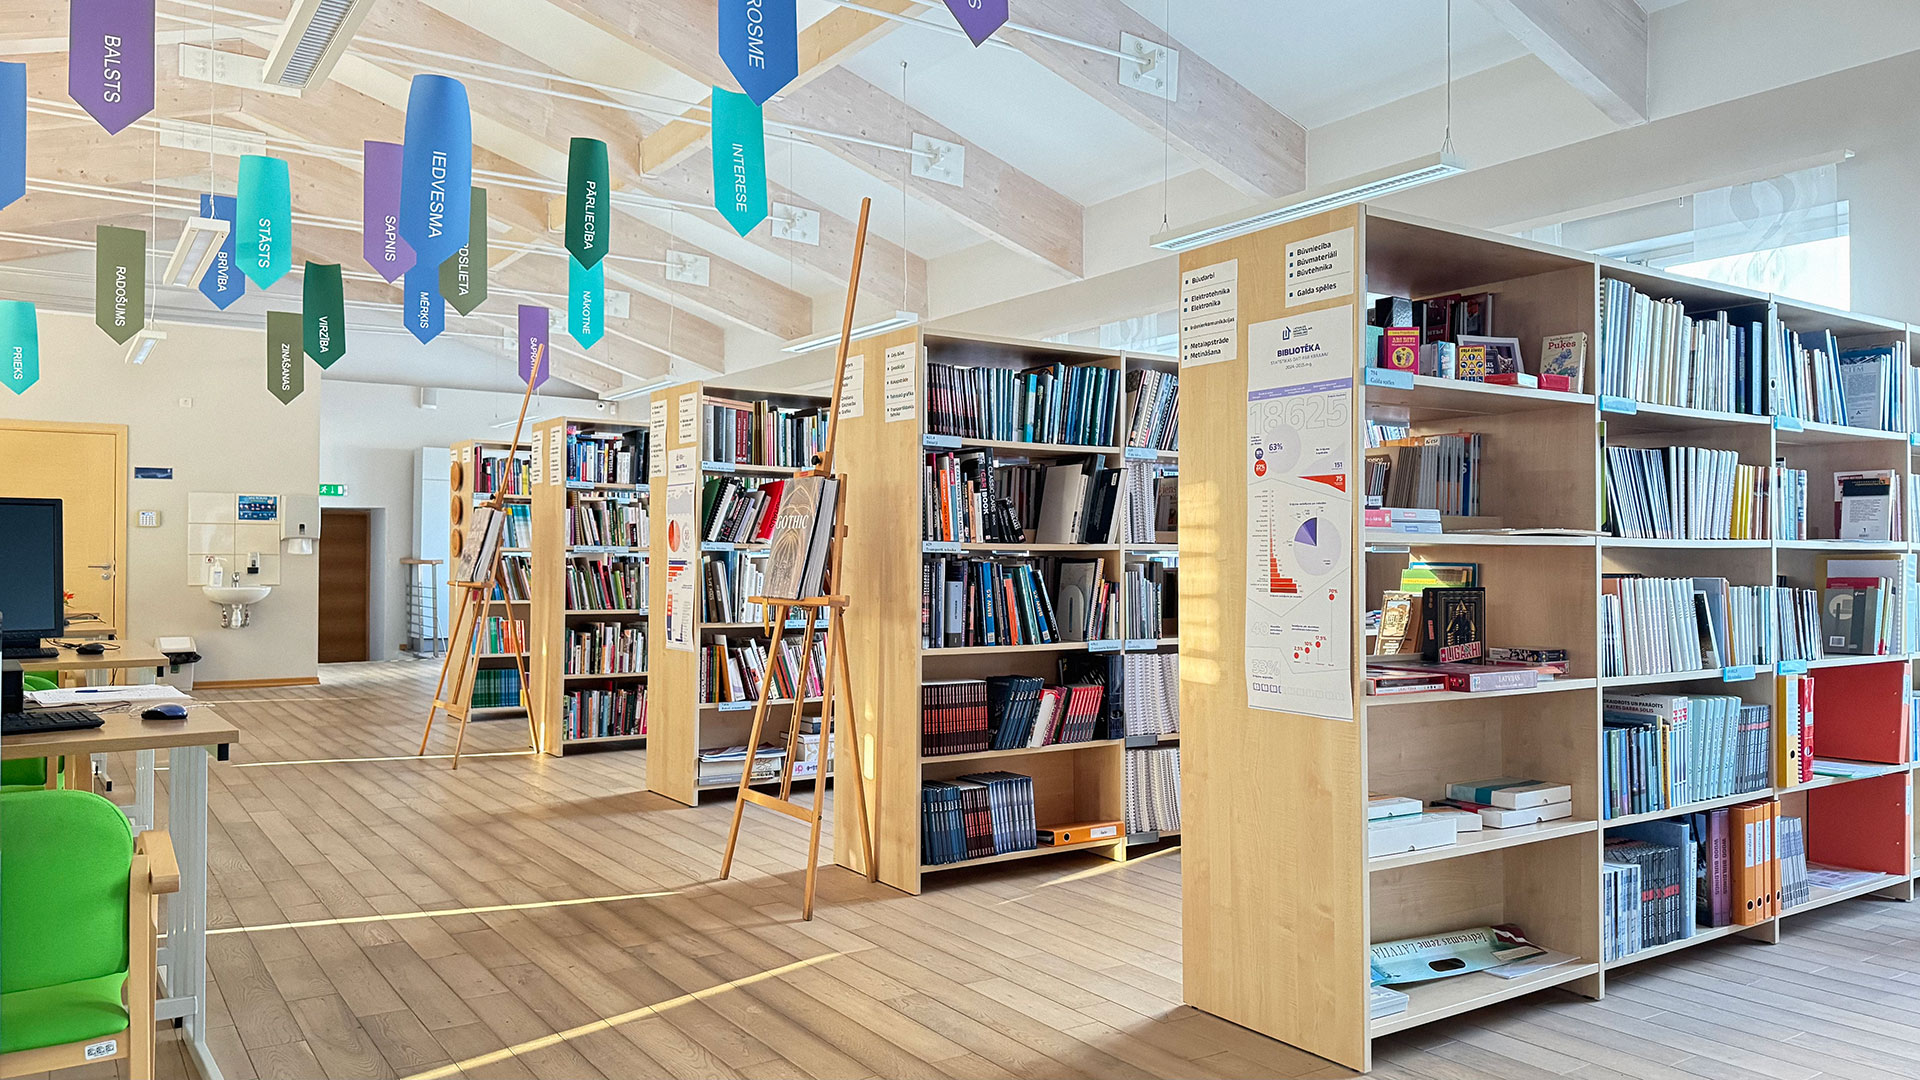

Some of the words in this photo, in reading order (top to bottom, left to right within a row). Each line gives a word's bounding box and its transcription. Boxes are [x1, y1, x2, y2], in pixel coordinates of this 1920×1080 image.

[103, 34, 122, 104] BALSTS
[731, 142, 748, 214] INTERESE
[428, 150, 448, 240] IEDVESMA
[583, 180, 597, 250] PĀRLIECĪBA
[258, 217, 271, 269] STĀSTS
[384, 214, 396, 262] SAPNIS
[1296, 241, 1332, 256] Būvniecība
[217, 250, 228, 292] BRĪVĪBA
[1296, 250, 1338, 267] Būvmateriāli
[1296, 262, 1333, 277] Būvtehnika
[115, 264, 128, 328] RADOŠUMS
[1191, 287, 1230, 302] Elektrotehnika
[1296, 286, 1314, 297] Galda
[1315, 282, 1337, 295] spēles
[417, 290, 430, 329] MĒRĶIS
[582, 290, 592, 335] NĀKOTNE
[1191, 300, 1221, 312] Elektronika
[318, 316, 330, 354] VIRZĪBA
[1548, 340, 1576, 350] Puķes
[13, 346, 23, 380] PRIEKS
[1277, 343, 1320, 358] BIBLIOTĒKA
[281, 342, 292, 391] ZINĀŠANAS
[1250, 394, 1348, 435] 18625
[1268, 443, 1283, 451] 63%
[988, 466, 996, 493] CLASSIC
[776, 514, 809, 529] GOTHIC
[1036, 600, 1044, 617] BMW
[1372, 943, 1418, 960] LATVIJA
[1417, 938, 1441, 950] zeme
[1442, 932, 1487, 945] Iedvesmas
